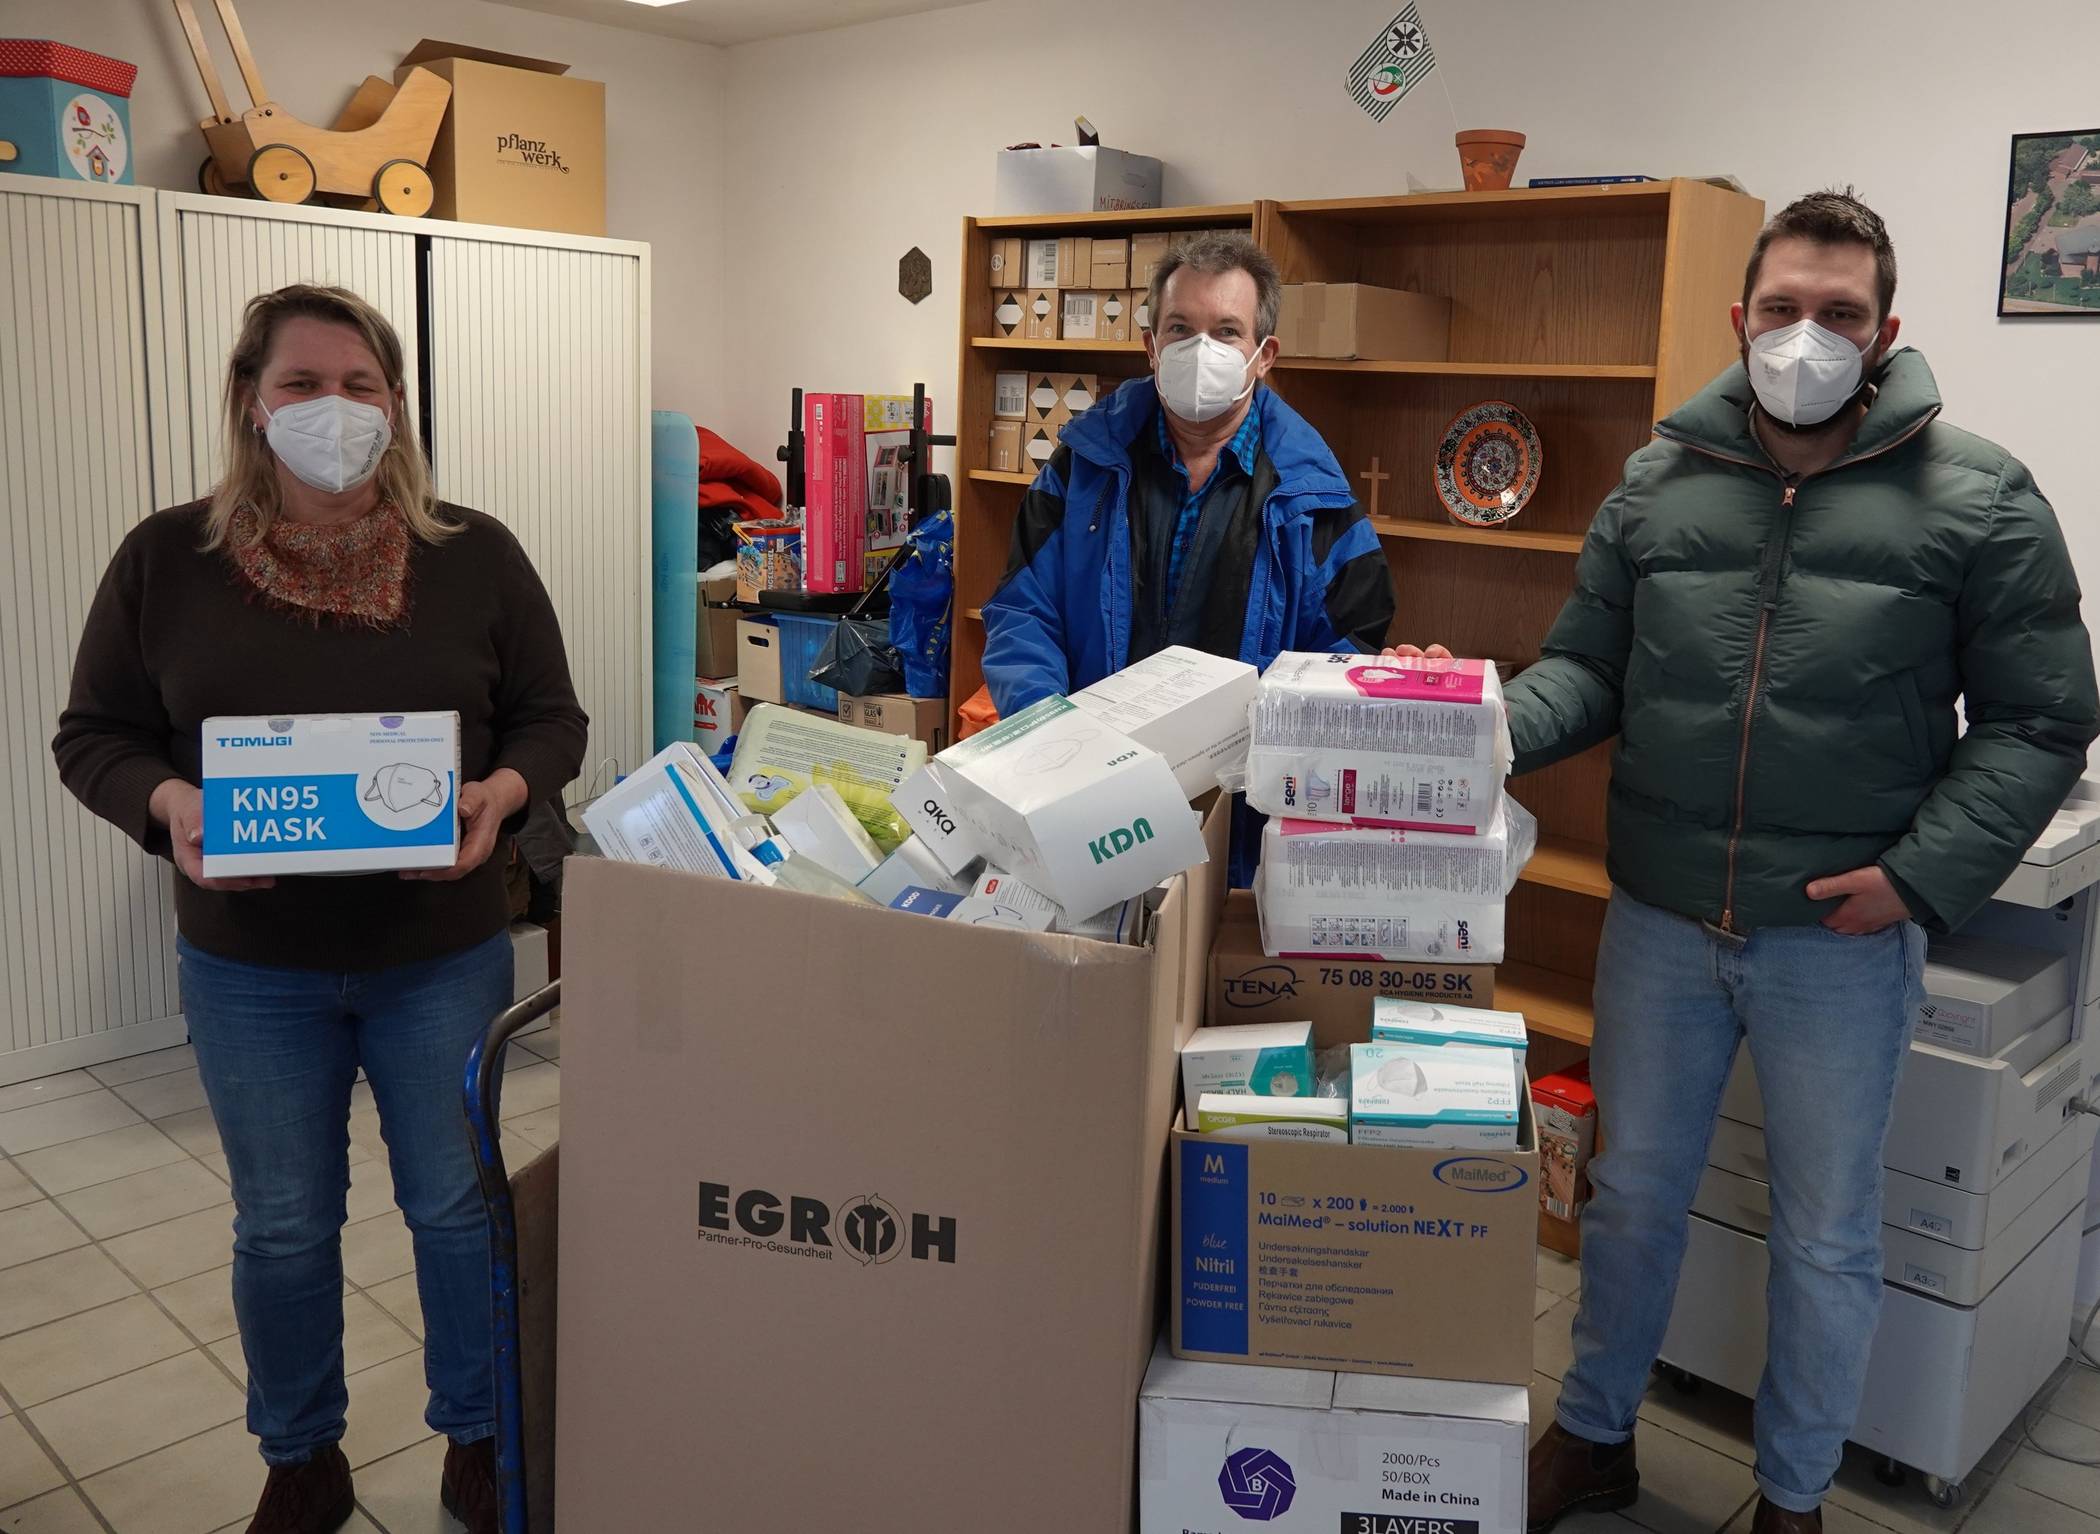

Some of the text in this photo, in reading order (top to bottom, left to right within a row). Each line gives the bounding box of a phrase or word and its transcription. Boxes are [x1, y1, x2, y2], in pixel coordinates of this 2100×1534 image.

[497, 133, 546, 152] pflanz
[521, 151, 569, 174] werk
[216, 736, 292, 747] TOMUGI
[232, 785, 319, 812] KN95
[1283, 775, 1296, 806] seni
[924, 800, 956, 835] aka
[232, 816, 327, 844] MASK
[1457, 920, 1471, 950] seni
[1224, 979, 1298, 996] TENA
[1320, 968, 1473, 991] 75 08 30-05 SK
[1267, 1126, 1331, 1138] Stereoscopic Respirator
[1204, 1154, 1225, 1175] M
[1200, 1176, 1229, 1185] medium
[1258, 1192, 1276, 1205] 10
[1312, 1199, 1321, 1209] x
[1326, 1197, 1355, 1211] 200
[1381, 1204, 1407, 1214] 2.000
[1348, 1219, 1409, 1235] solution
[1414, 1219, 1465, 1238] NEXT
[1471, 1225, 1489, 1238] PF
[1921, 1218, 1935, 1229] A4
[697, 1229, 833, 1261] Partner-Pro-Gesundheit
[1202, 1232, 1227, 1249] blue
[1195, 1257, 1235, 1275] Nitril
[1193, 1282, 1237, 1294] PUDERFREI
[1914, 1273, 1928, 1285] A3
[1186, 1298, 1244, 1311] POWDER FREE
[1382, 1452, 1440, 1468] 2000/Pcs
[1382, 1470, 1431, 1485] 50/BOX
[1382, 1488, 1480, 1506] Made in China
